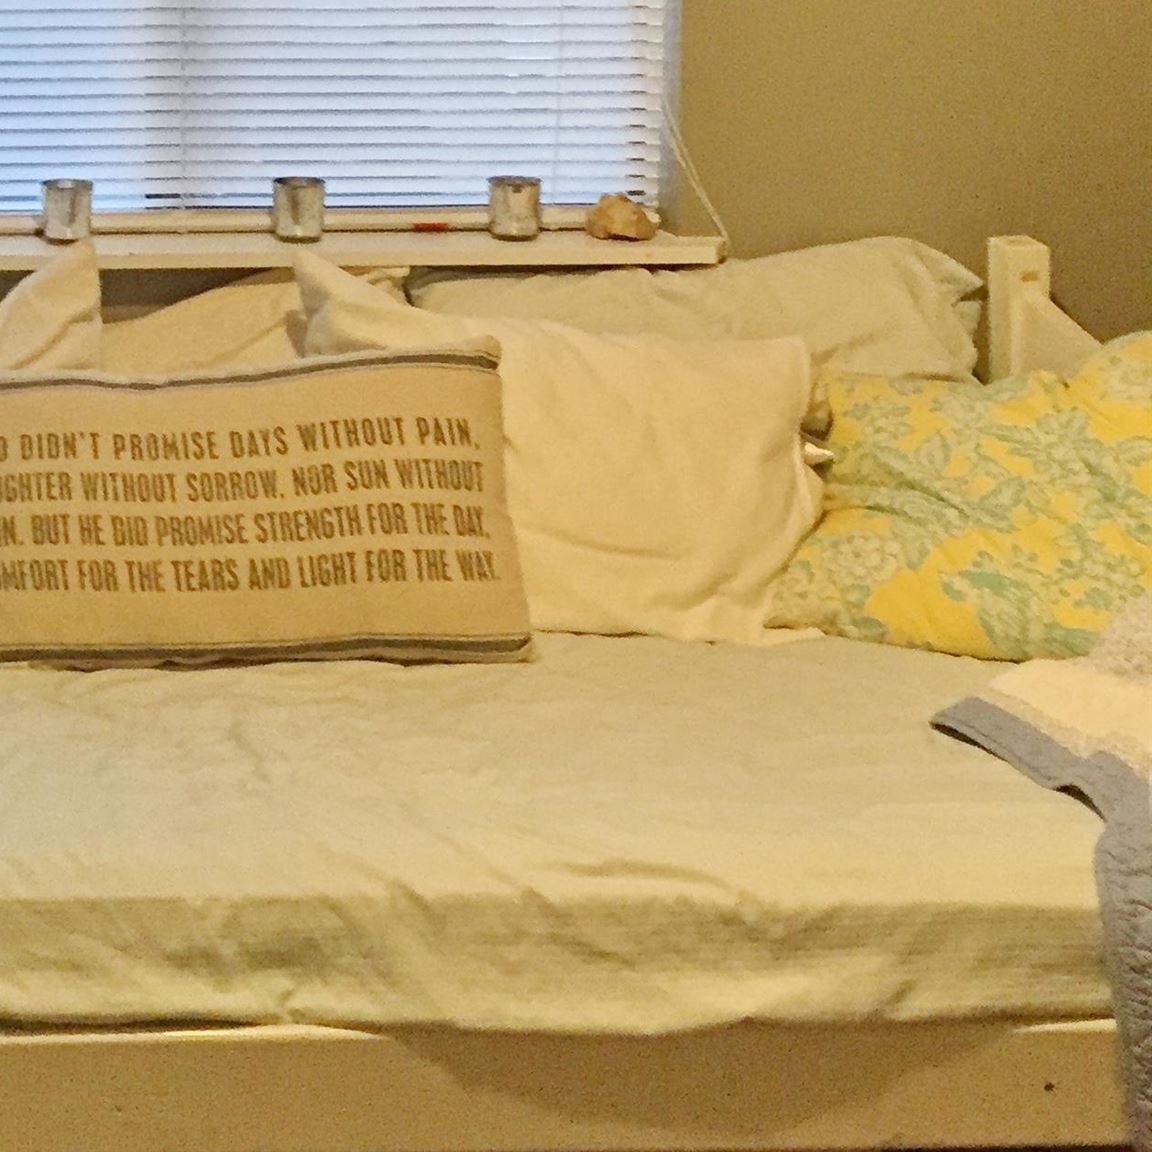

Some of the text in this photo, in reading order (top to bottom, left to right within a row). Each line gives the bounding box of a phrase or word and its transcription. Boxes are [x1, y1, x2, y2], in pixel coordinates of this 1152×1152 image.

[20, 432, 100, 460] DIDN'T
[113, 431, 219, 461] PROMISE
[229, 426, 288, 458] DAYS
[296, 417, 405, 452] WITHOUT
[80, 472, 176, 502] WITHOUT
[292, 463, 338, 496] NOR
[344, 459, 391, 491] SUN
[394, 458, 483, 493] WITHOUT
[31, 514, 70, 546] BUT
[78, 515, 104, 546] HE
[111, 516, 148, 547] DID
[155, 513, 249, 547] PROMISE
[254, 504, 362, 544] STRENGTH
[367, 502, 408, 536] FOR
[410, 502, 450, 536] THE
[77, 559, 118, 592] FOR
[124, 560, 165, 592] THE
[170, 559, 241, 592] TEARS
[248, 557, 291, 591] AND
[296, 551, 357, 588] LIGHT
[364, 549, 407, 583] FOR
[412, 549, 452, 582] THE
